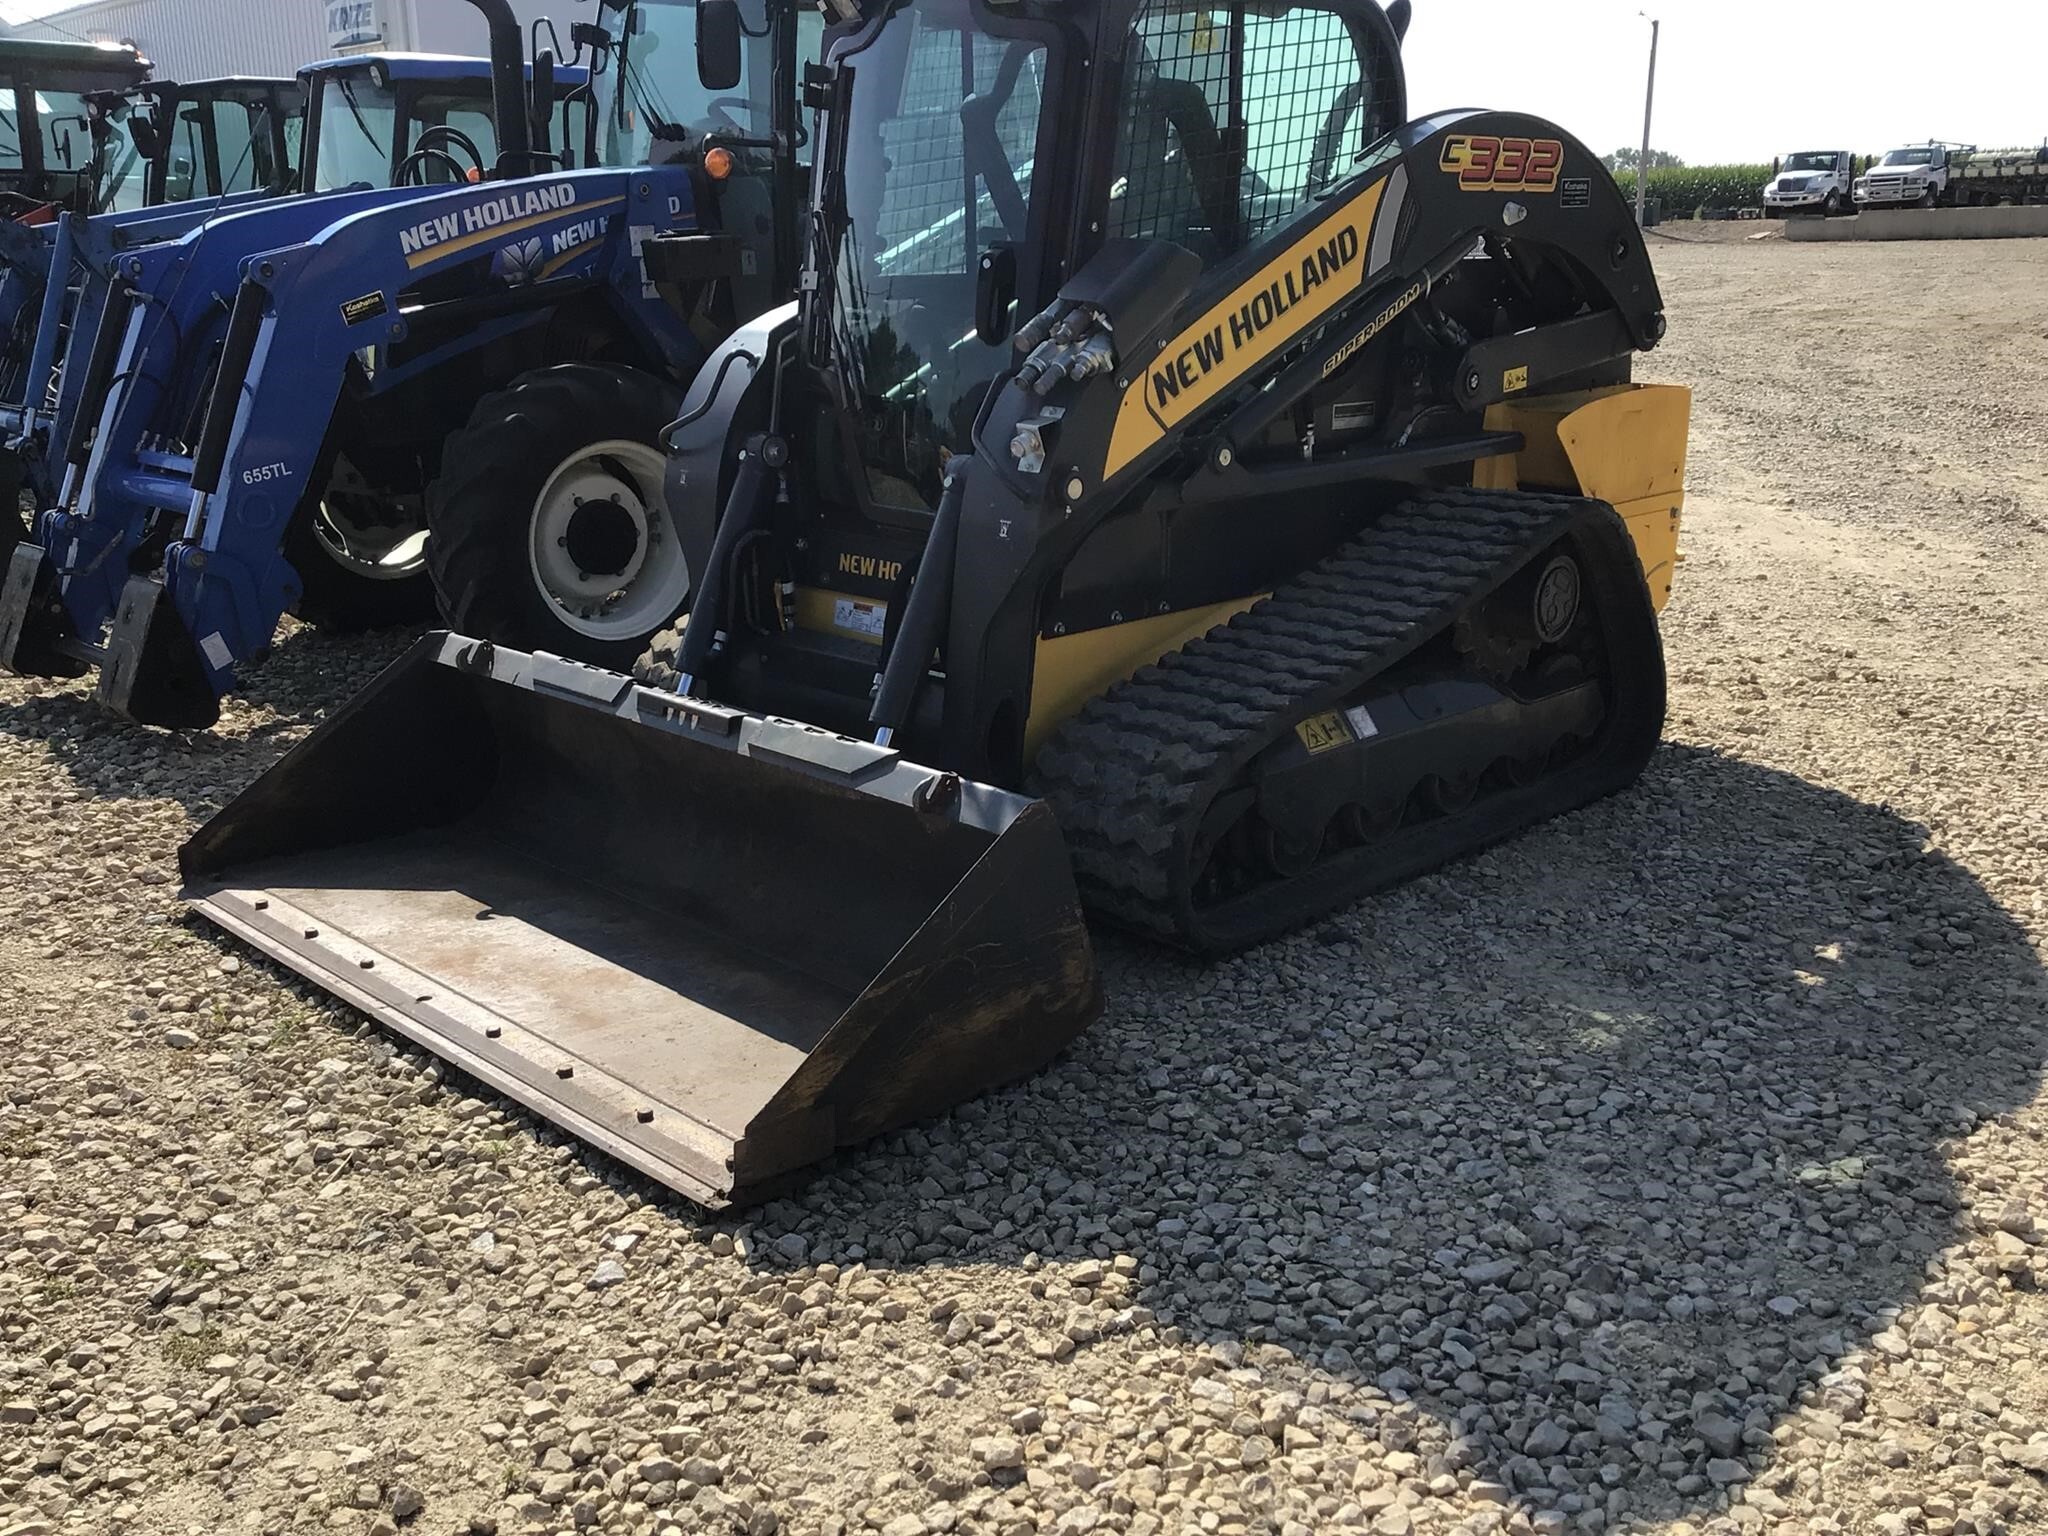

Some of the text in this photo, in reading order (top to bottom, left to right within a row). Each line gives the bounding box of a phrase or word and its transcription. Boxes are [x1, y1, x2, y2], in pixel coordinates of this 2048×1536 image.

[400, 213, 460, 255] NEW
[463, 183, 576, 232] HOLLAND
[552, 219, 595, 255] NEW
[1152, 224, 1359, 408] NEW HOLLAND
[1322, 283, 1420, 379] SUPER BOOM
[243, 462, 292, 485] 655TL
[839, 553, 876, 577] NEW
